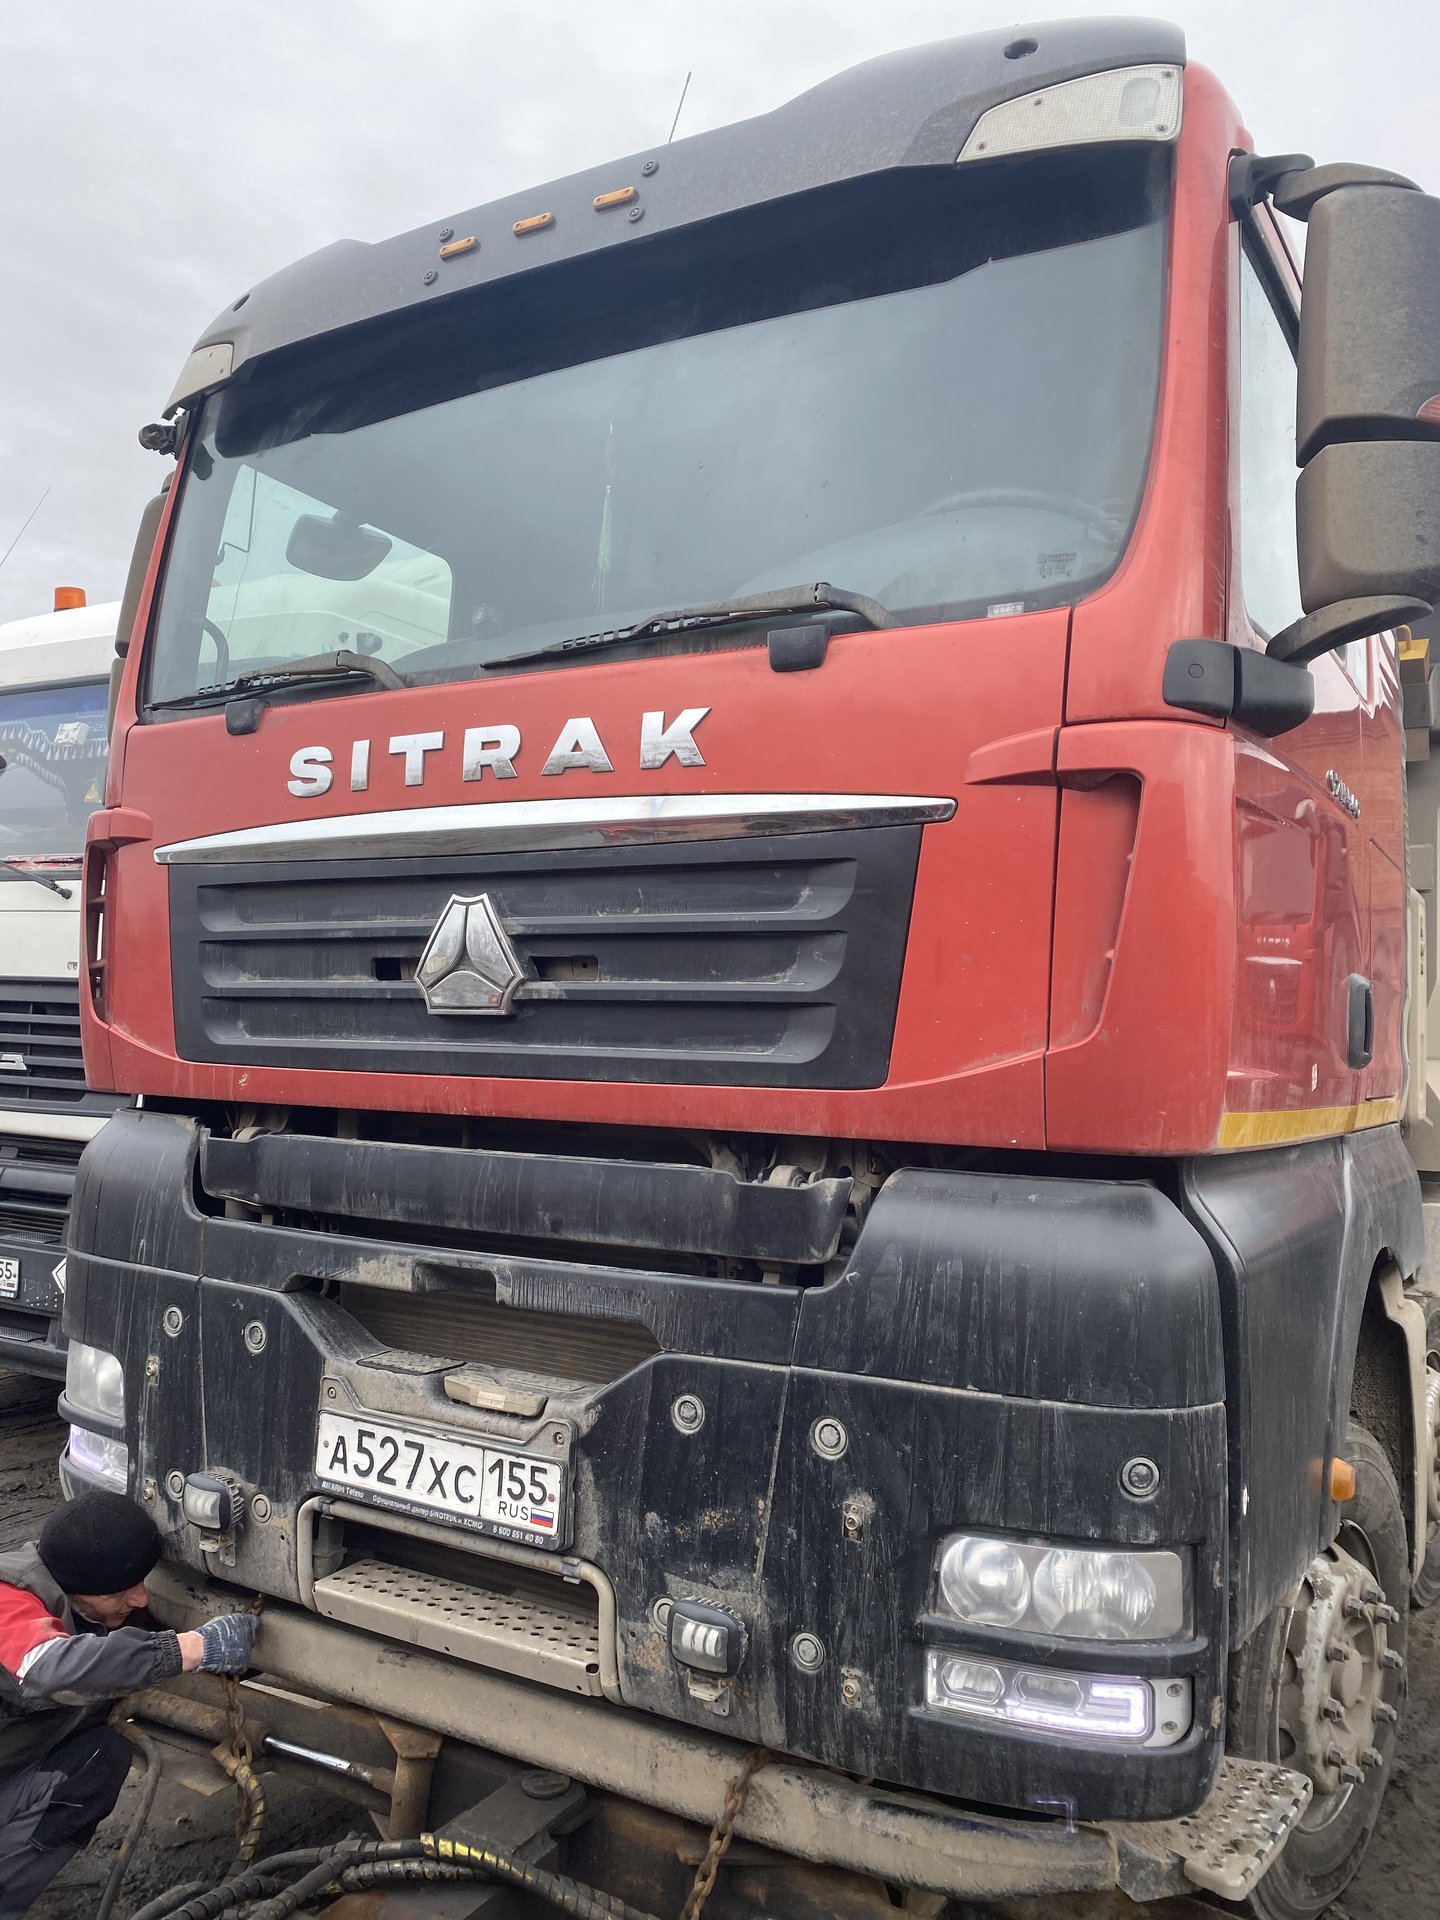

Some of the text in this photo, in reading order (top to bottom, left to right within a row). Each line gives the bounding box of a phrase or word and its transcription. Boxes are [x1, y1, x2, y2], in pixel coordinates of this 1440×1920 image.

[287, 707, 712, 798] SITRAK
[488, 1458, 549, 1506] 155
[498, 1501, 529, 1521] RUS
[463, 1518, 484, 1530] XCMG
[511, 1529, 523, 1540] 551
[524, 1533, 534, 1543] 40
